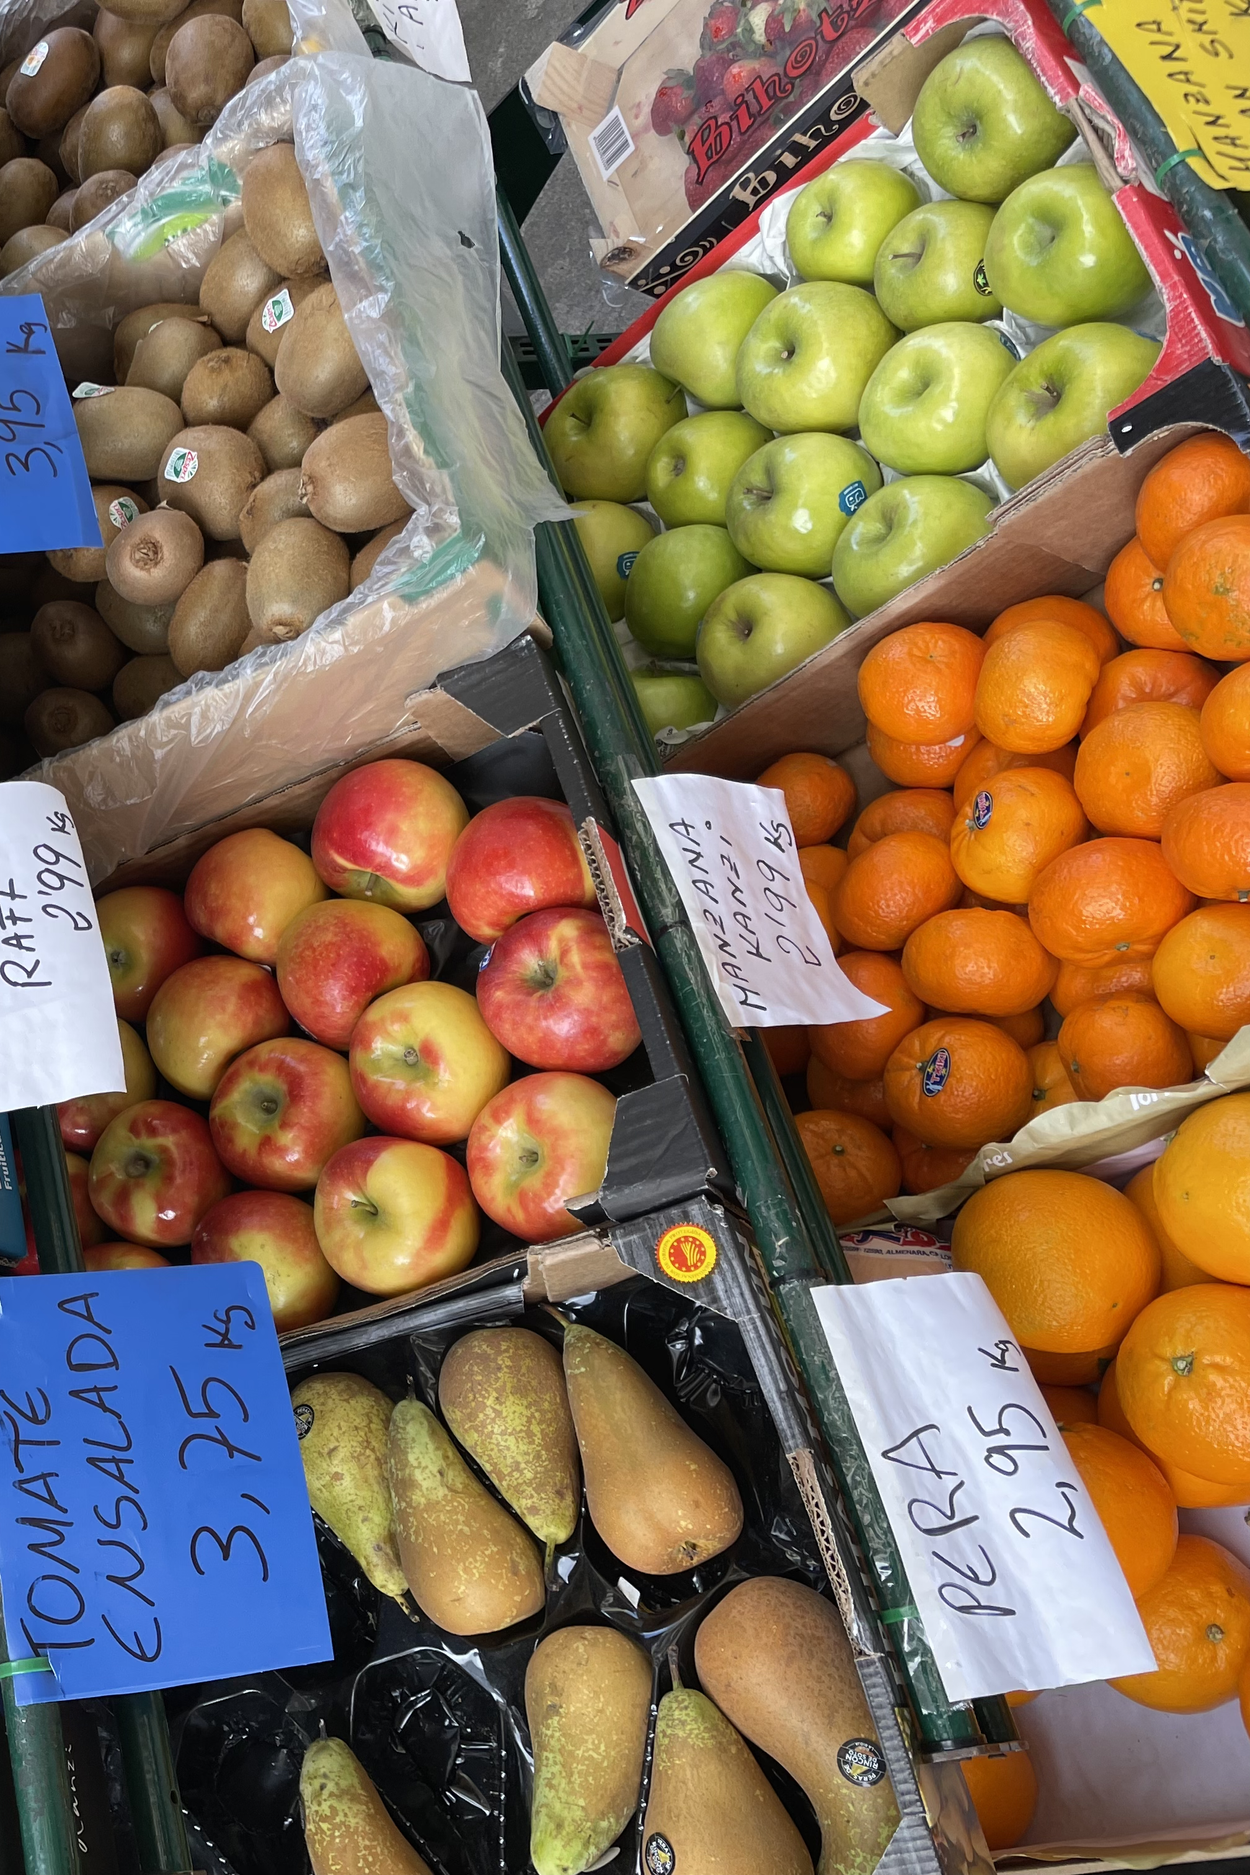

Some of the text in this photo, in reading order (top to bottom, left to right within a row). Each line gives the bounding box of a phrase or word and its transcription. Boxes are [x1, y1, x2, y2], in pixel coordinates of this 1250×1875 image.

[5, 321, 48, 355] Kg
[33, 811, 93, 931] 2'99 Kg
[668, 817, 768, 1012] MANZANA
[759, 819, 794, 854] Kg
[0, 1387, 95, 1658] TOMATE
[56, 1292, 163, 1662] ENSALADA
[169, 1304, 271, 1583] 3,75 Kg
[881, 1423, 1017, 1617] PERA
[967, 1339, 1085, 1540] 2,95 Kg
